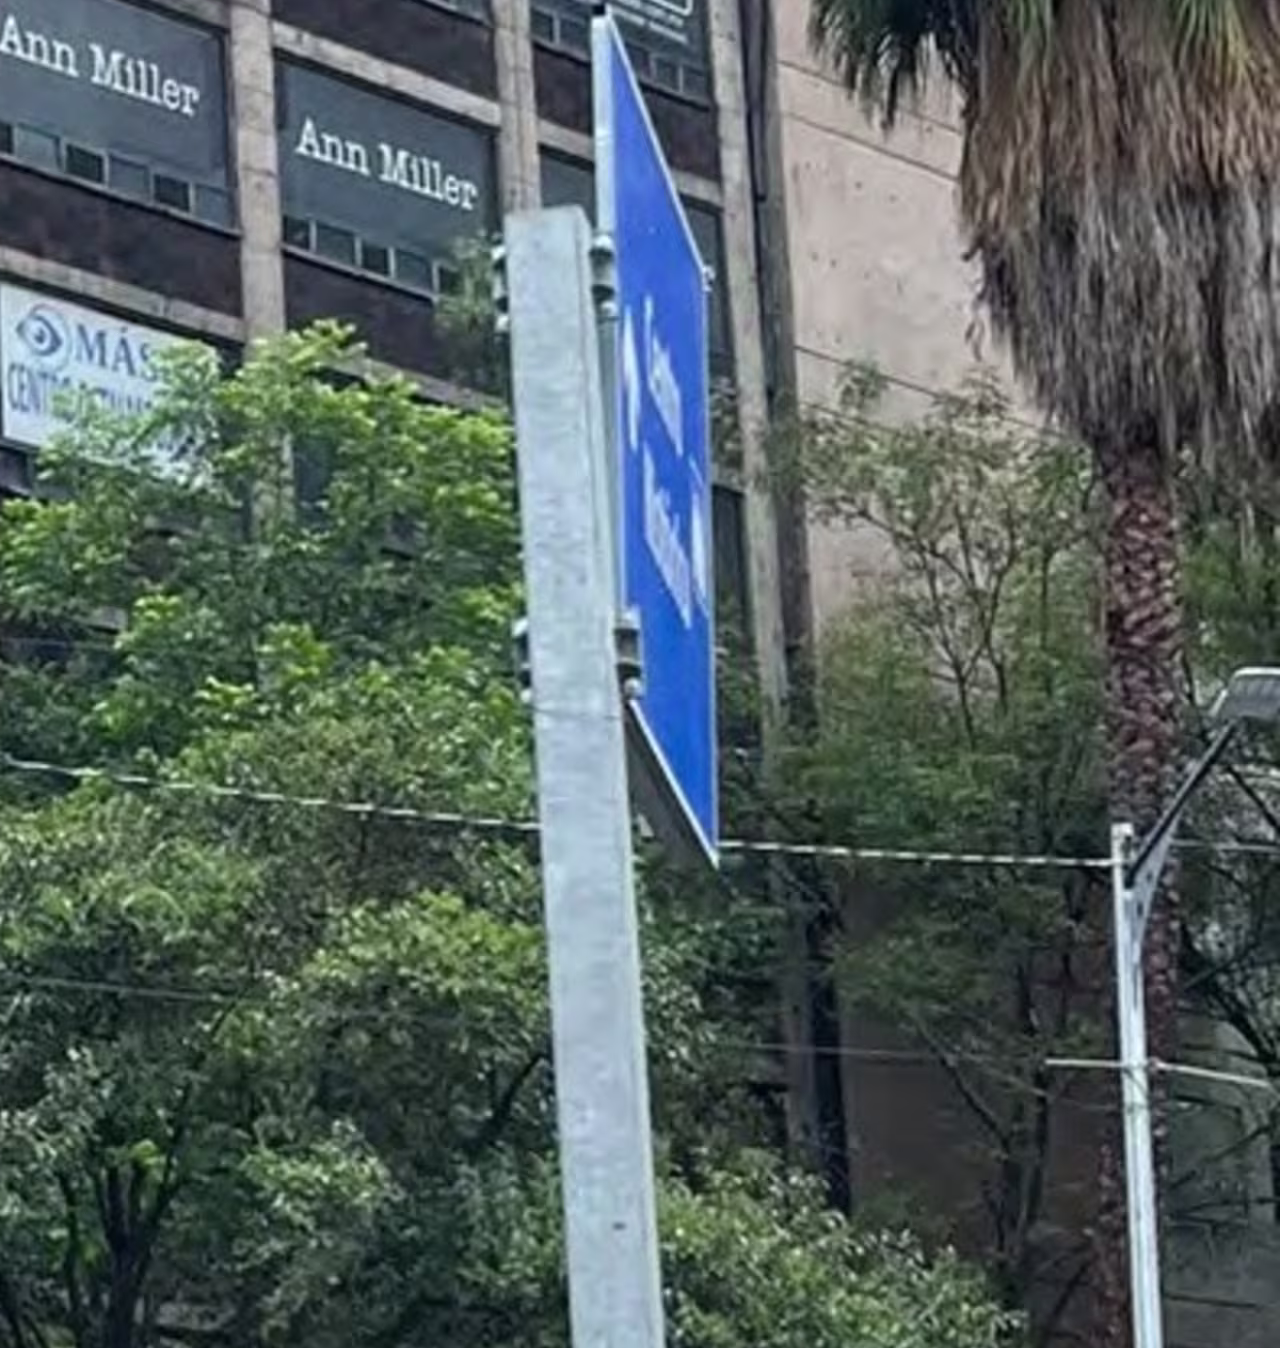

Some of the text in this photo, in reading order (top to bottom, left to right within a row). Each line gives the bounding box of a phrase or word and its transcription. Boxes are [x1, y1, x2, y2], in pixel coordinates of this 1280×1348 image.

[89, 43, 200, 117] Miller
[295, 117, 478, 210] Ann Miller
